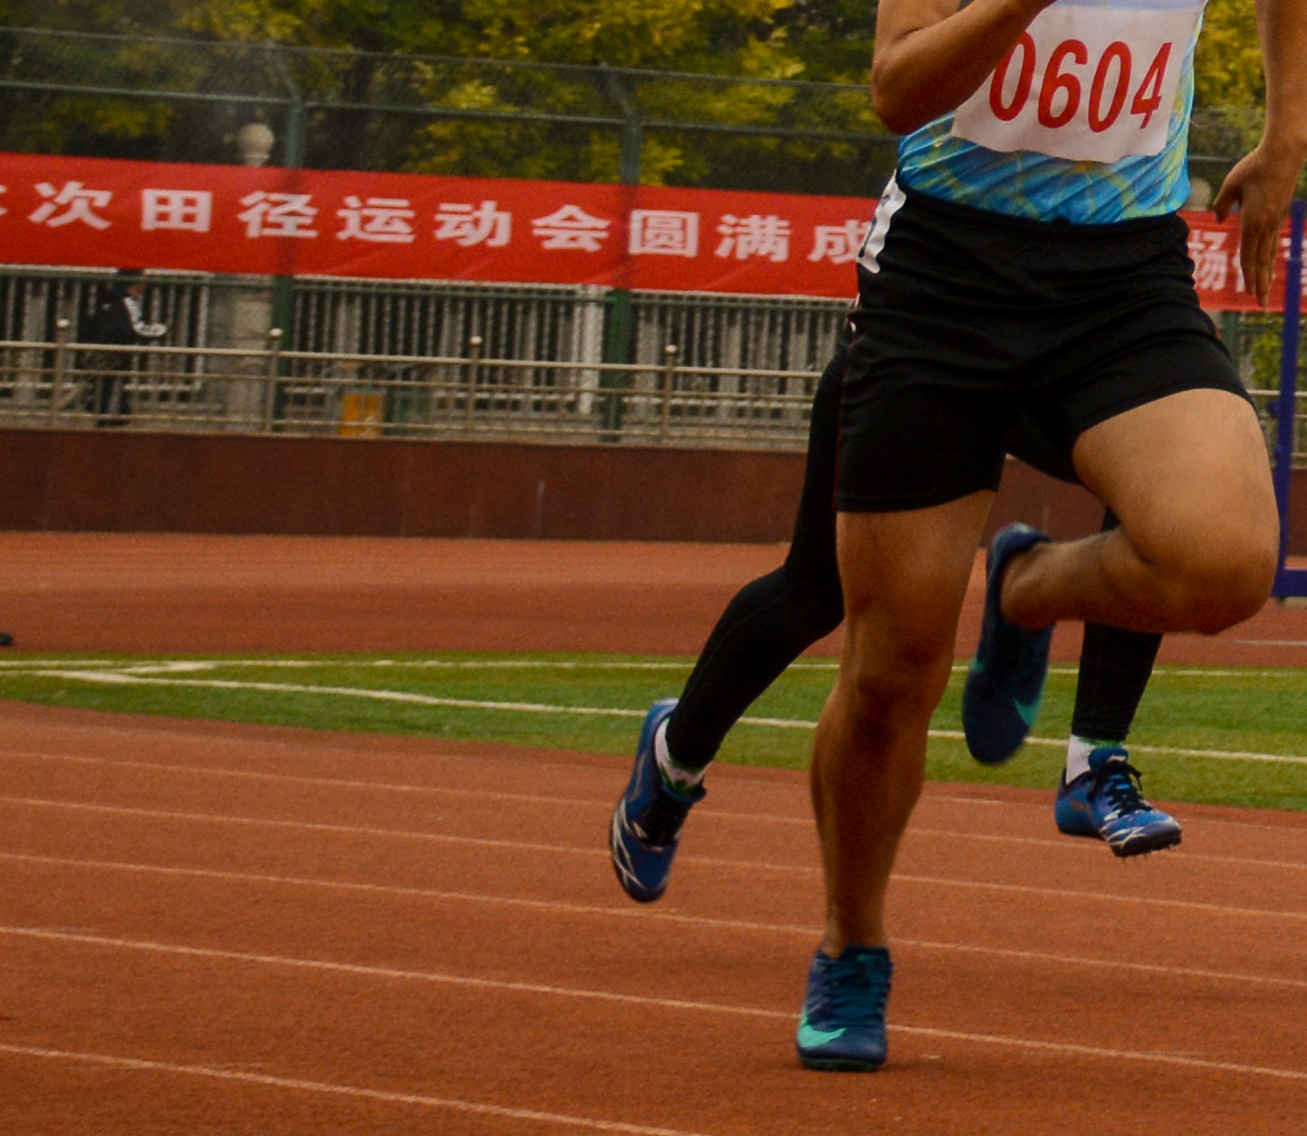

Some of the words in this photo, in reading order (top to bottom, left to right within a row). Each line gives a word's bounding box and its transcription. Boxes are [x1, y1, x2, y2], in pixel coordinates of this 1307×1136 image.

[988, 31, 1173, 134] 0604
[0, 180, 873, 263] 次田径运动会圆满成
